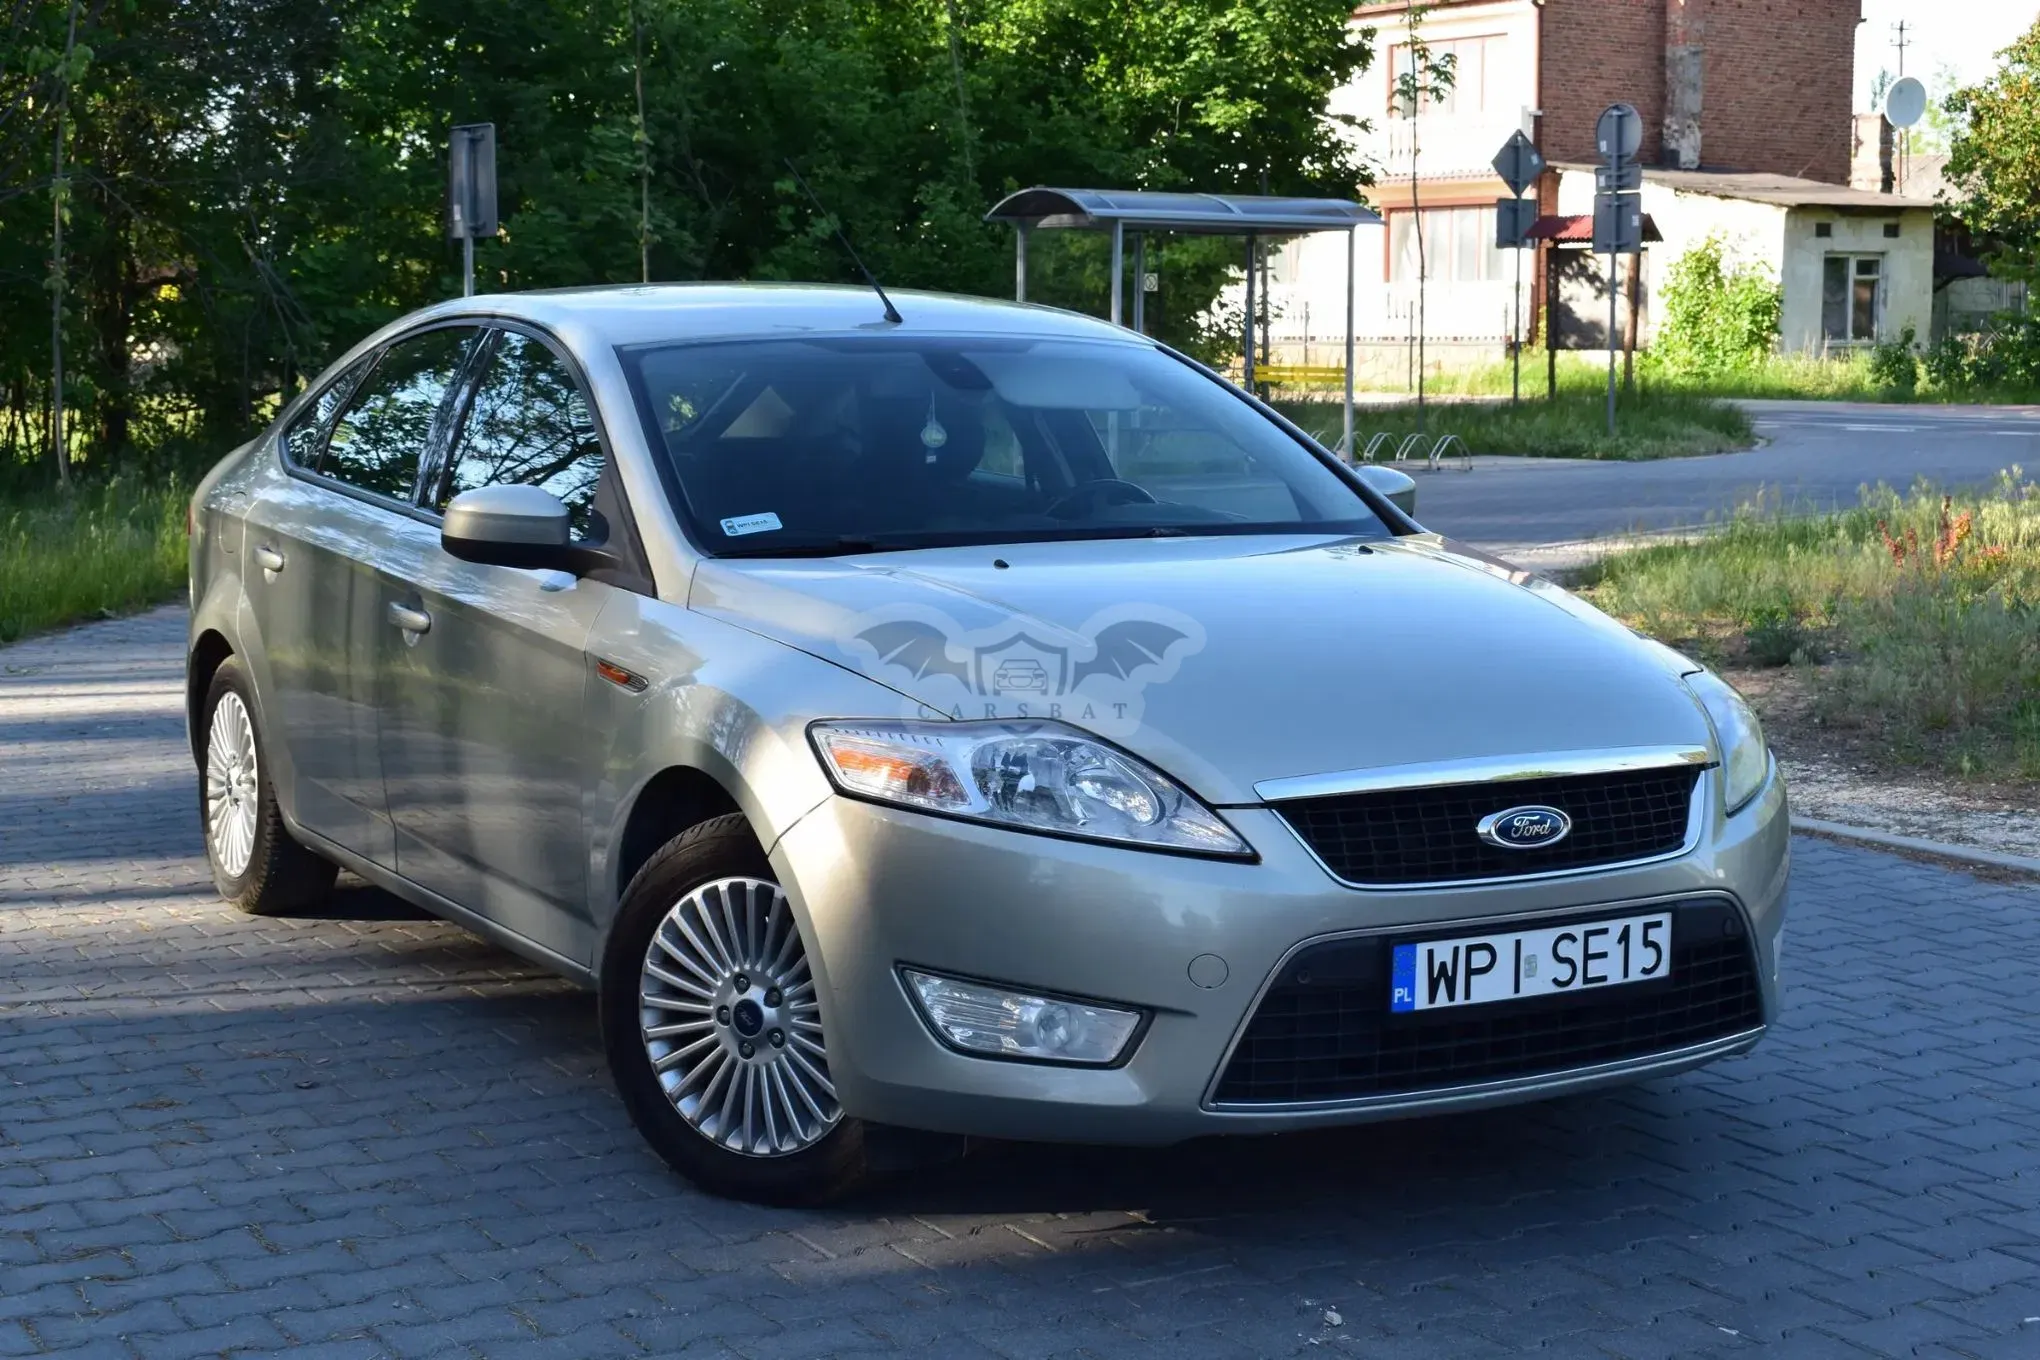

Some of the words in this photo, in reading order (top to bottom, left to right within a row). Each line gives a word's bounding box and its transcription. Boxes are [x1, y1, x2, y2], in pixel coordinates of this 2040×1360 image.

[1511, 815, 1551, 838] Ford
[1551, 920, 1663, 988] SE15
[1394, 987, 1412, 1003] PL
